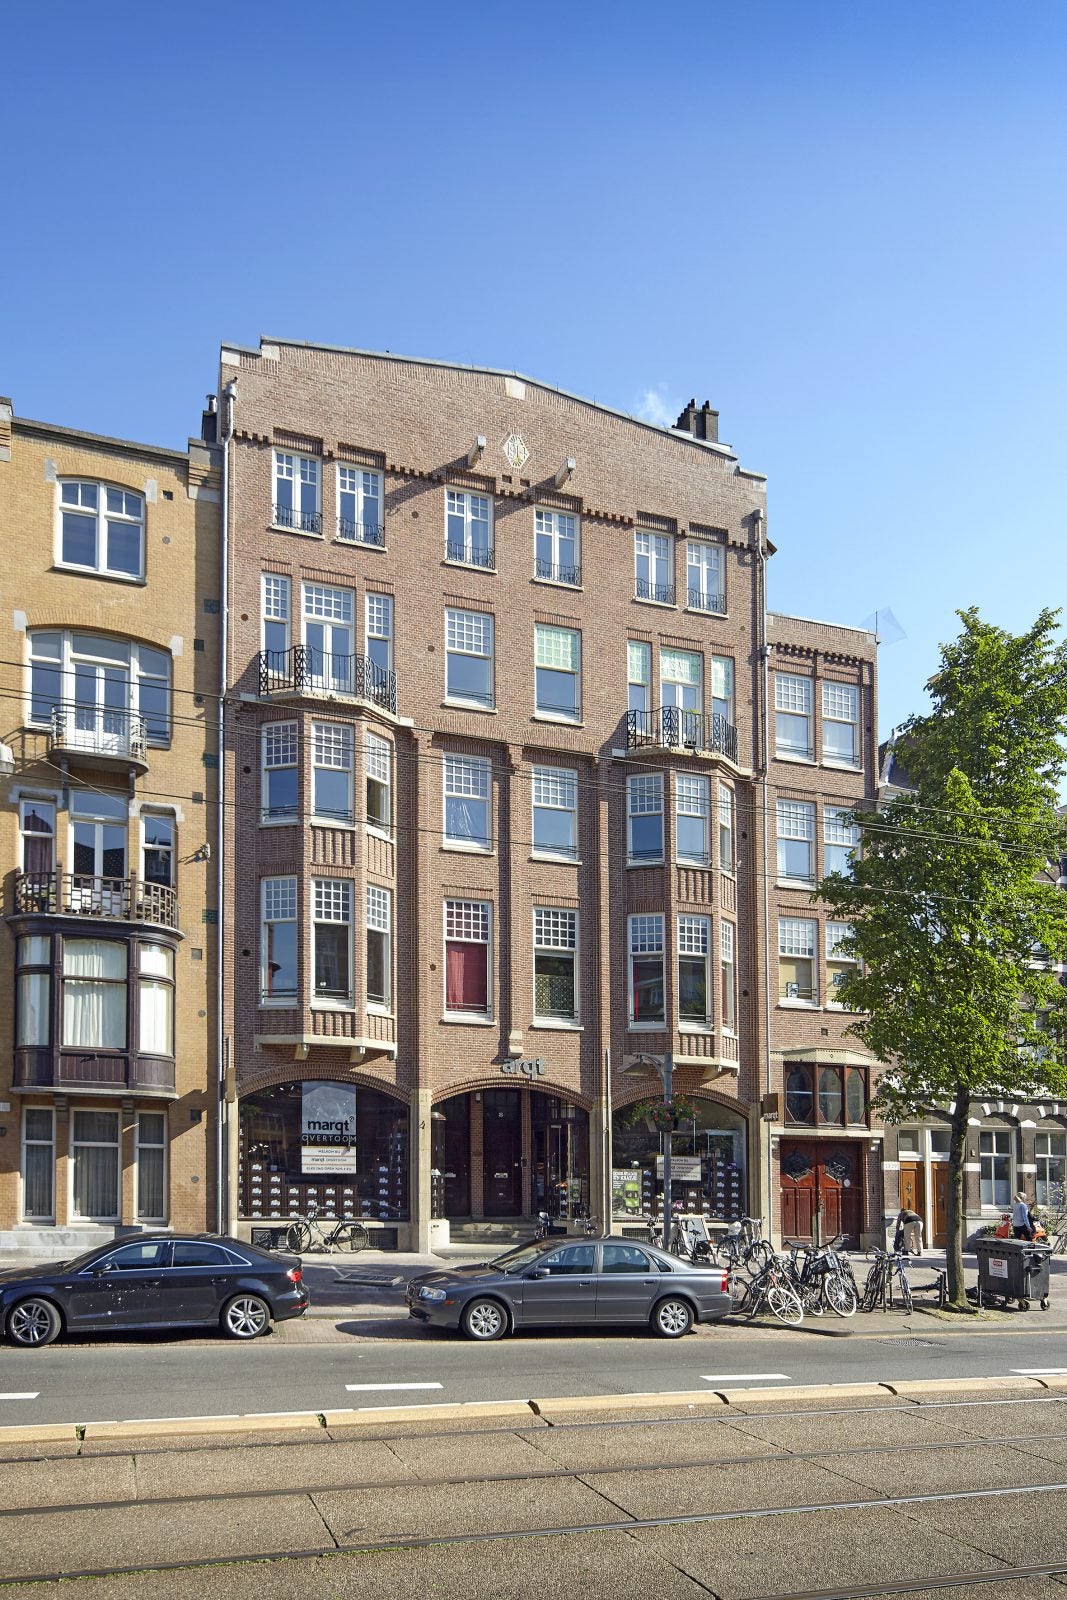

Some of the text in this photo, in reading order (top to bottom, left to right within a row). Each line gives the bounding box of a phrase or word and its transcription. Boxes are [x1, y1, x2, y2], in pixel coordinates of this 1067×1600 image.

[501, 1057, 545, 1081] arqt
[307, 1120, 350, 1135] marqt
[301, 1134, 357, 1142] OVERTOOM
